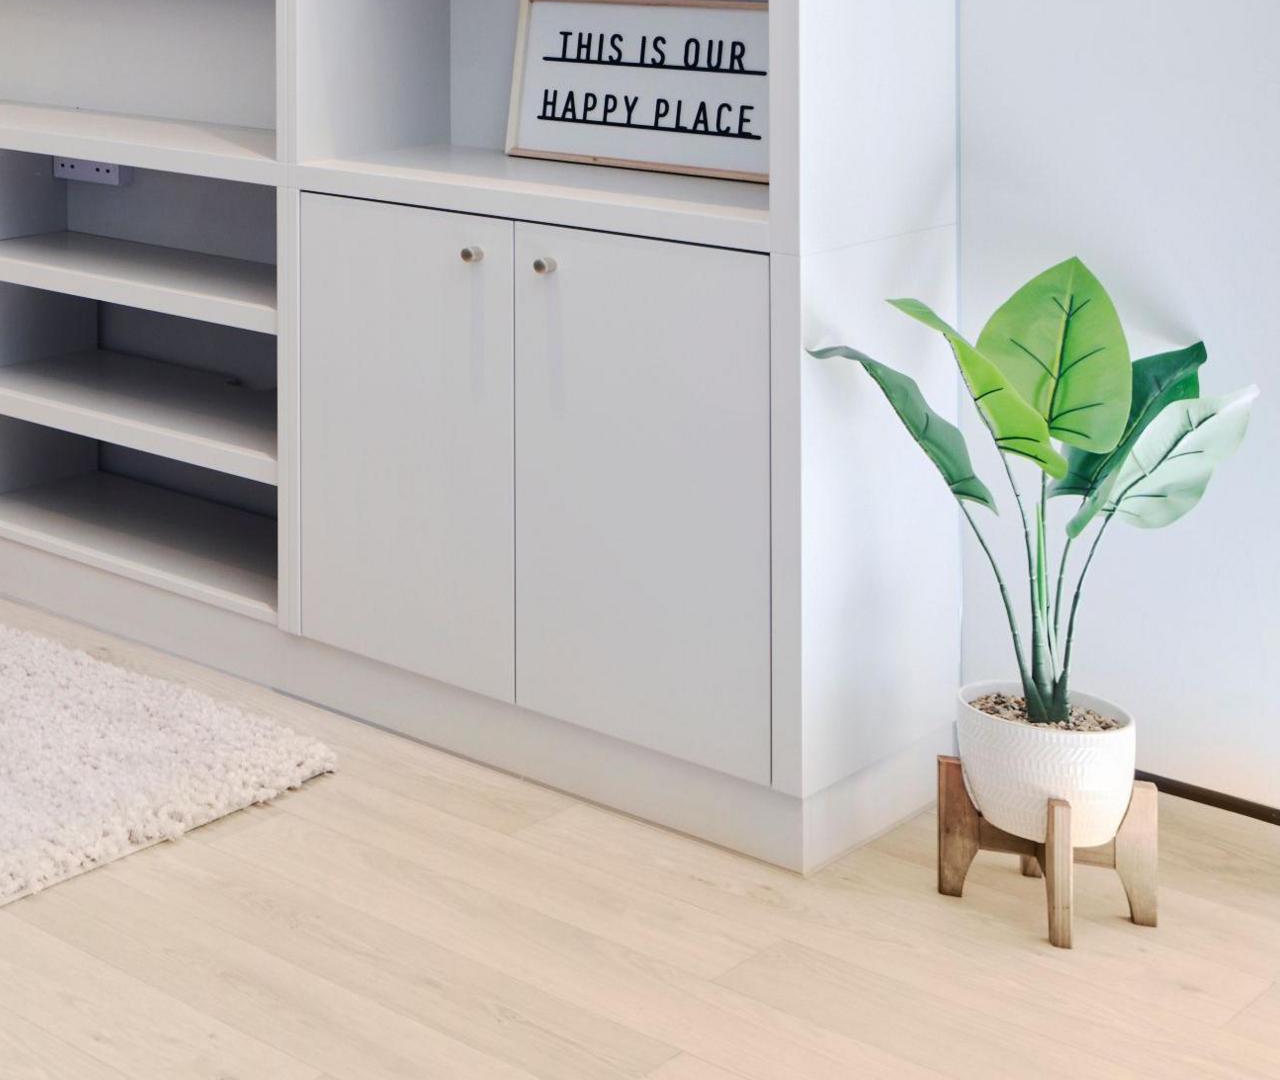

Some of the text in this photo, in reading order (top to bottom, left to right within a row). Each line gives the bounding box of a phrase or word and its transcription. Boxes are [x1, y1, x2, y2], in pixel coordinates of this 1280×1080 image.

[559, 31, 746, 71] THIS IS OUR
[541, 89, 755, 137] HAPPY PLACE
